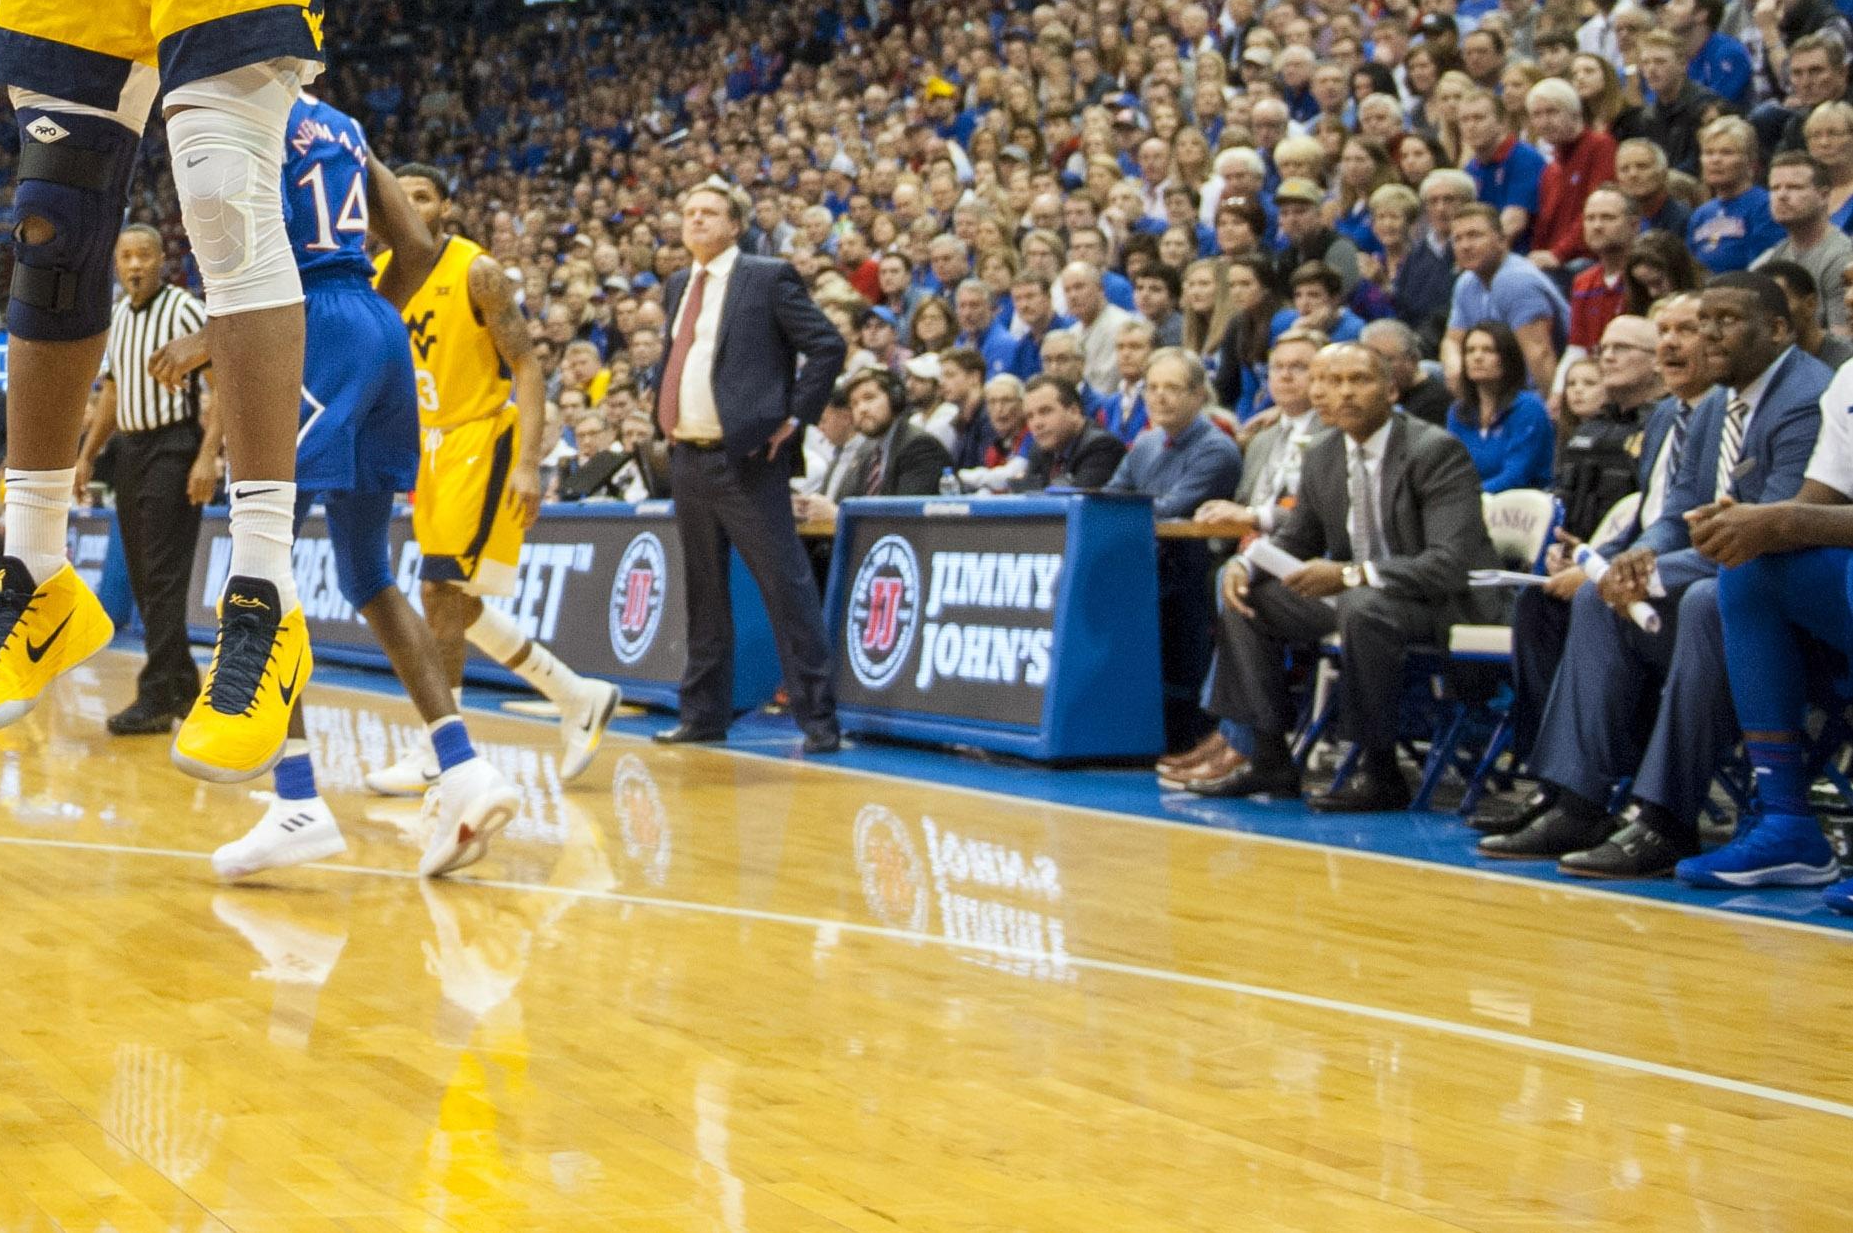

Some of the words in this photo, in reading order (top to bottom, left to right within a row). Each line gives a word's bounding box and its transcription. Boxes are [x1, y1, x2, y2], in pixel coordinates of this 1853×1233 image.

[35, 125, 56, 136] PRO
[297, 162, 368, 251] 14
[925, 551, 1062, 618] JIMMY
[915, 622, 1052, 690] JOHN'S
